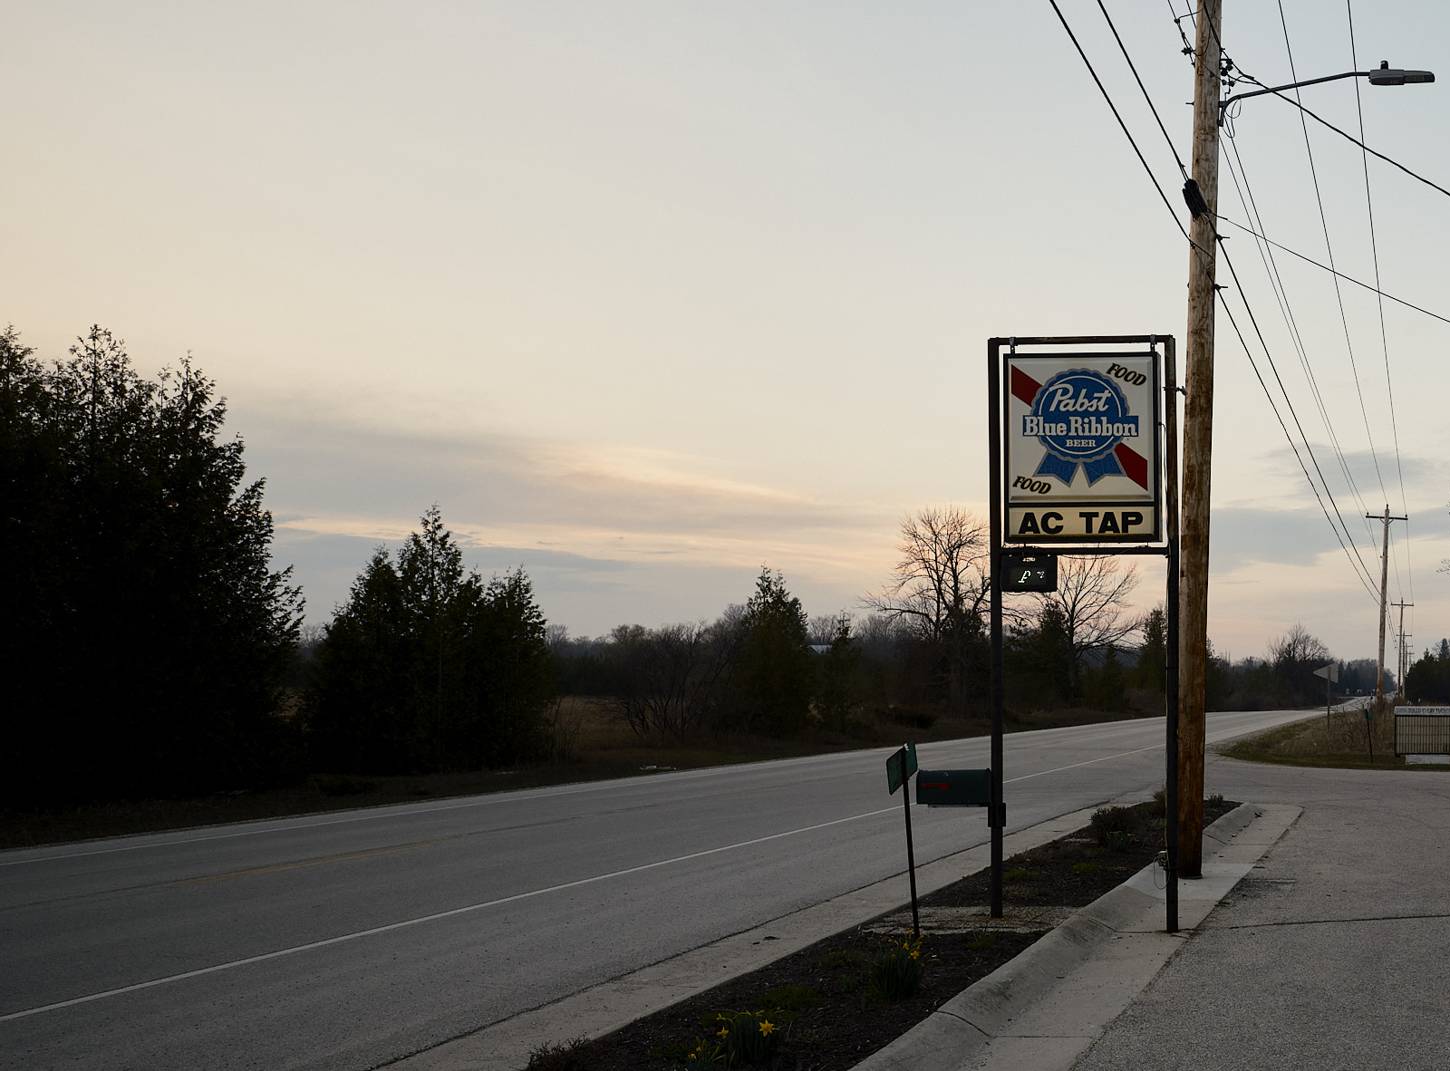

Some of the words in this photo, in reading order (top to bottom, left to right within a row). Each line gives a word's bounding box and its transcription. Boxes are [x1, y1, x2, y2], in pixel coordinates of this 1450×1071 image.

[1106, 362, 1147, 386] FOOD
[1048, 383, 1111, 412] Pabst
[1023, 416, 1067, 436] Blue
[1068, 416, 1138, 437] Ribbon
[1065, 439, 1097, 447] BEER
[1012, 475, 1051, 495] FOOD
[1018, 511, 1064, 534] AC
[1079, 511, 1144, 534] TAP
